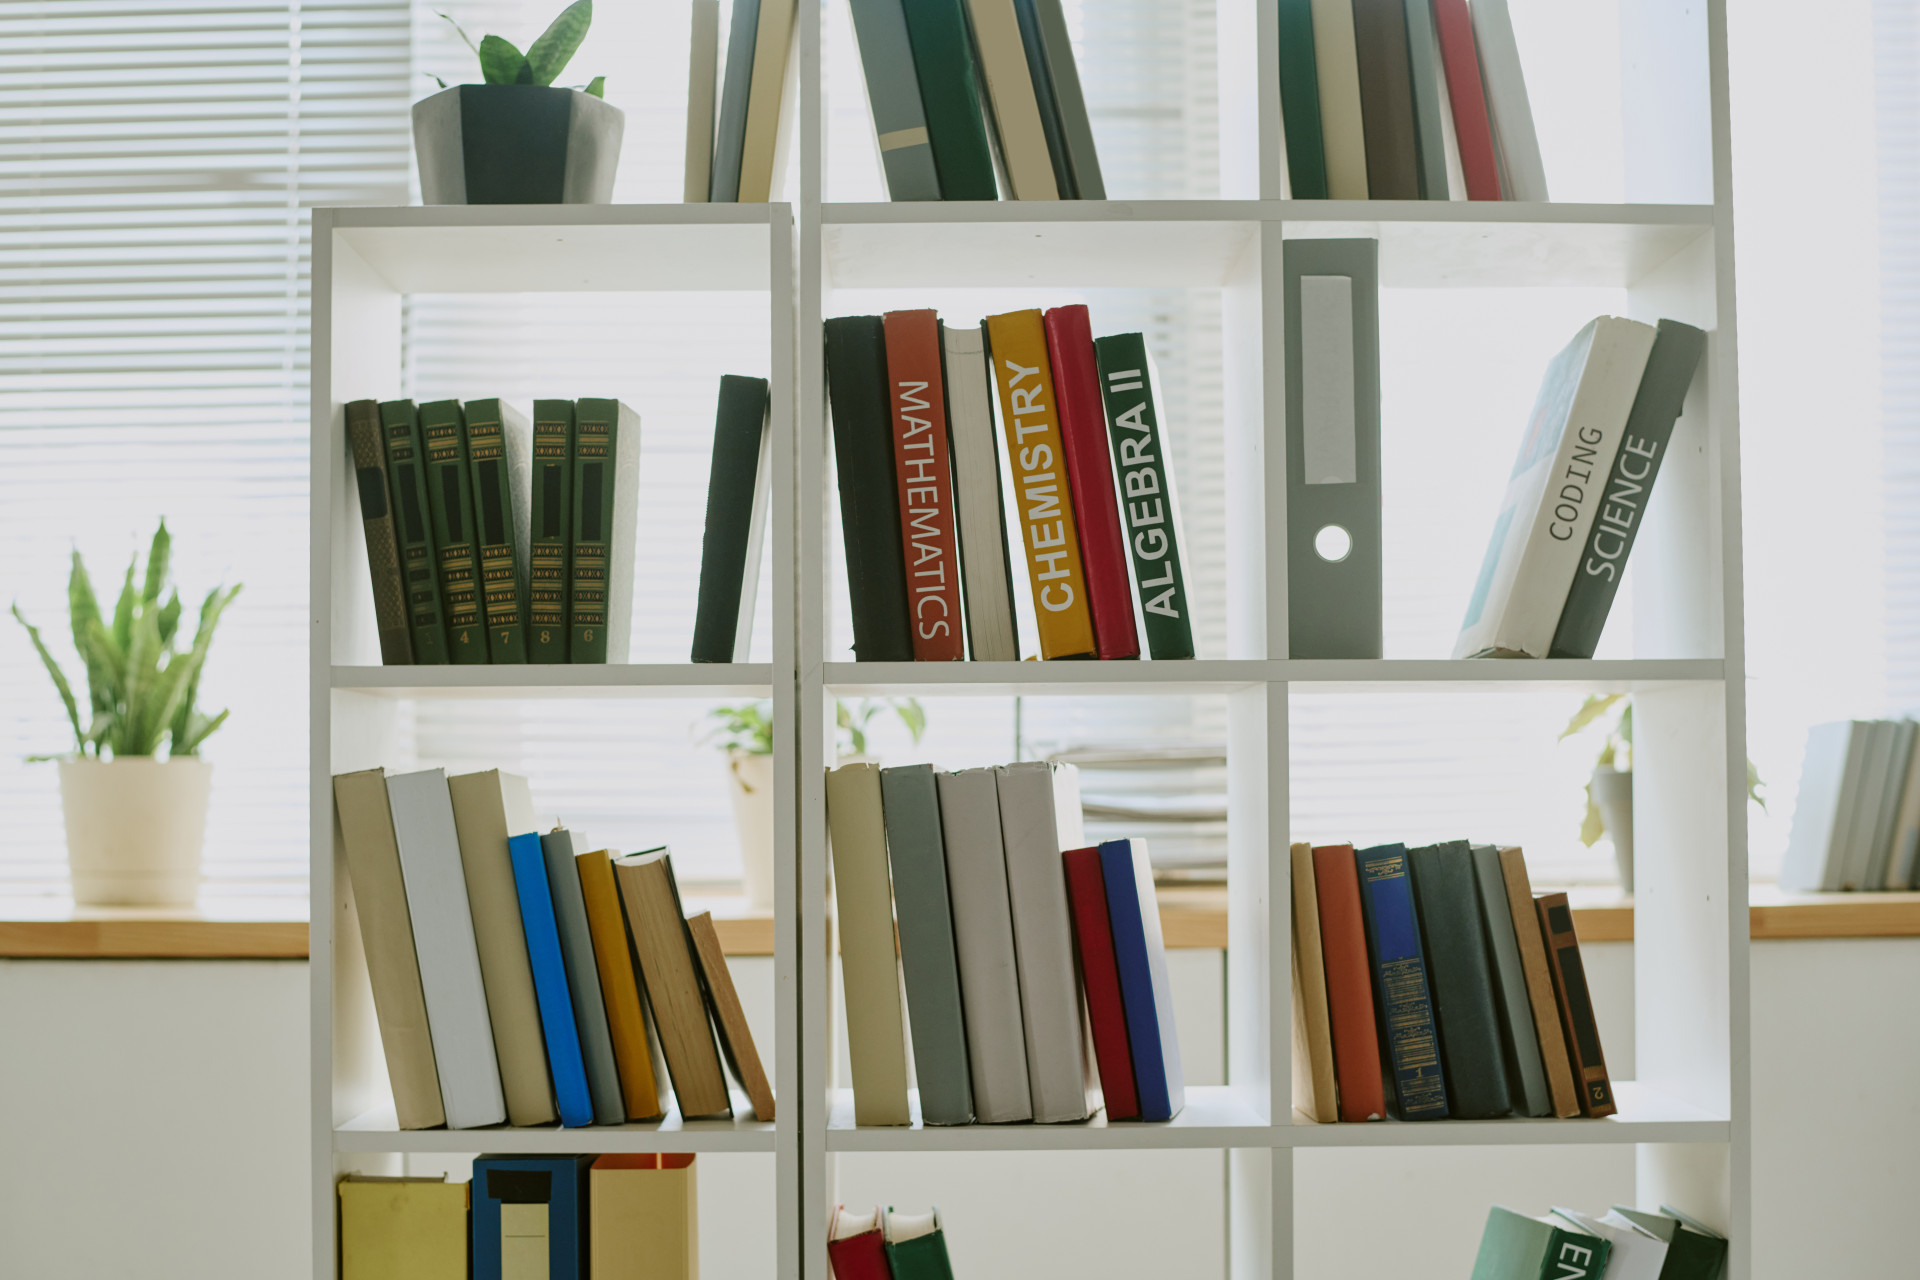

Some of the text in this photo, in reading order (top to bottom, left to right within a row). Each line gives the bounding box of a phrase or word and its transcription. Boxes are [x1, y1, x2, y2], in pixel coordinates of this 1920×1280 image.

[898, 381, 950, 640] MATHEMATICS
[1005, 359, 1074, 612] CHEMISTRY
[1107, 368, 1180, 619] ALGEBRA II
[1549, 425, 1603, 541] CODING
[1586, 434, 1658, 582] SCIENCE
[460, 630, 470, 644] 4
[501, 631, 510, 644] 7
[540, 630, 550, 644] 8
[583, 629, 593, 642] 6
